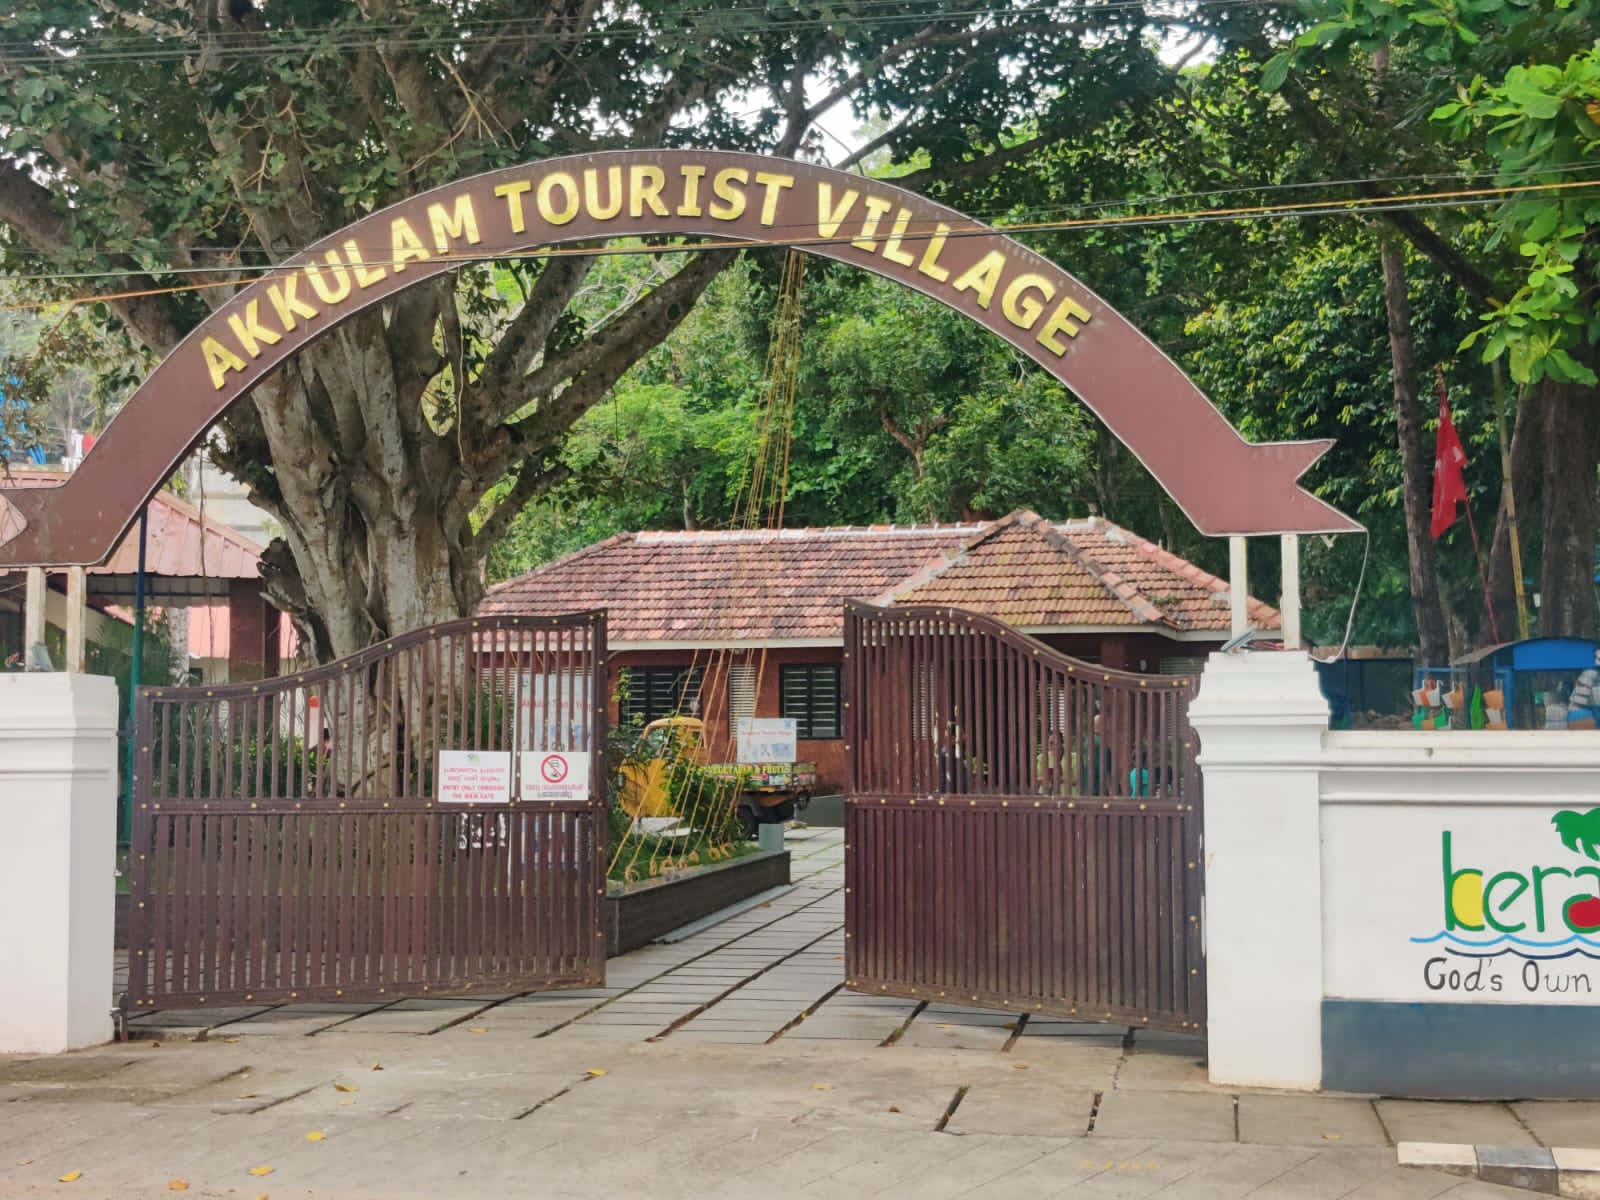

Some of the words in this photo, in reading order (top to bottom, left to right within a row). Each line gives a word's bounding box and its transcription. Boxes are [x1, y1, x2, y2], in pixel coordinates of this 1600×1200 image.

[200, 193, 482, 391] AKKULAM
[494, 165, 794, 234] TOURIST
[817, 182, 1092, 358] VILLAGE
[1424, 957, 1503, 992] God's
[1522, 960, 1592, 992] Own
